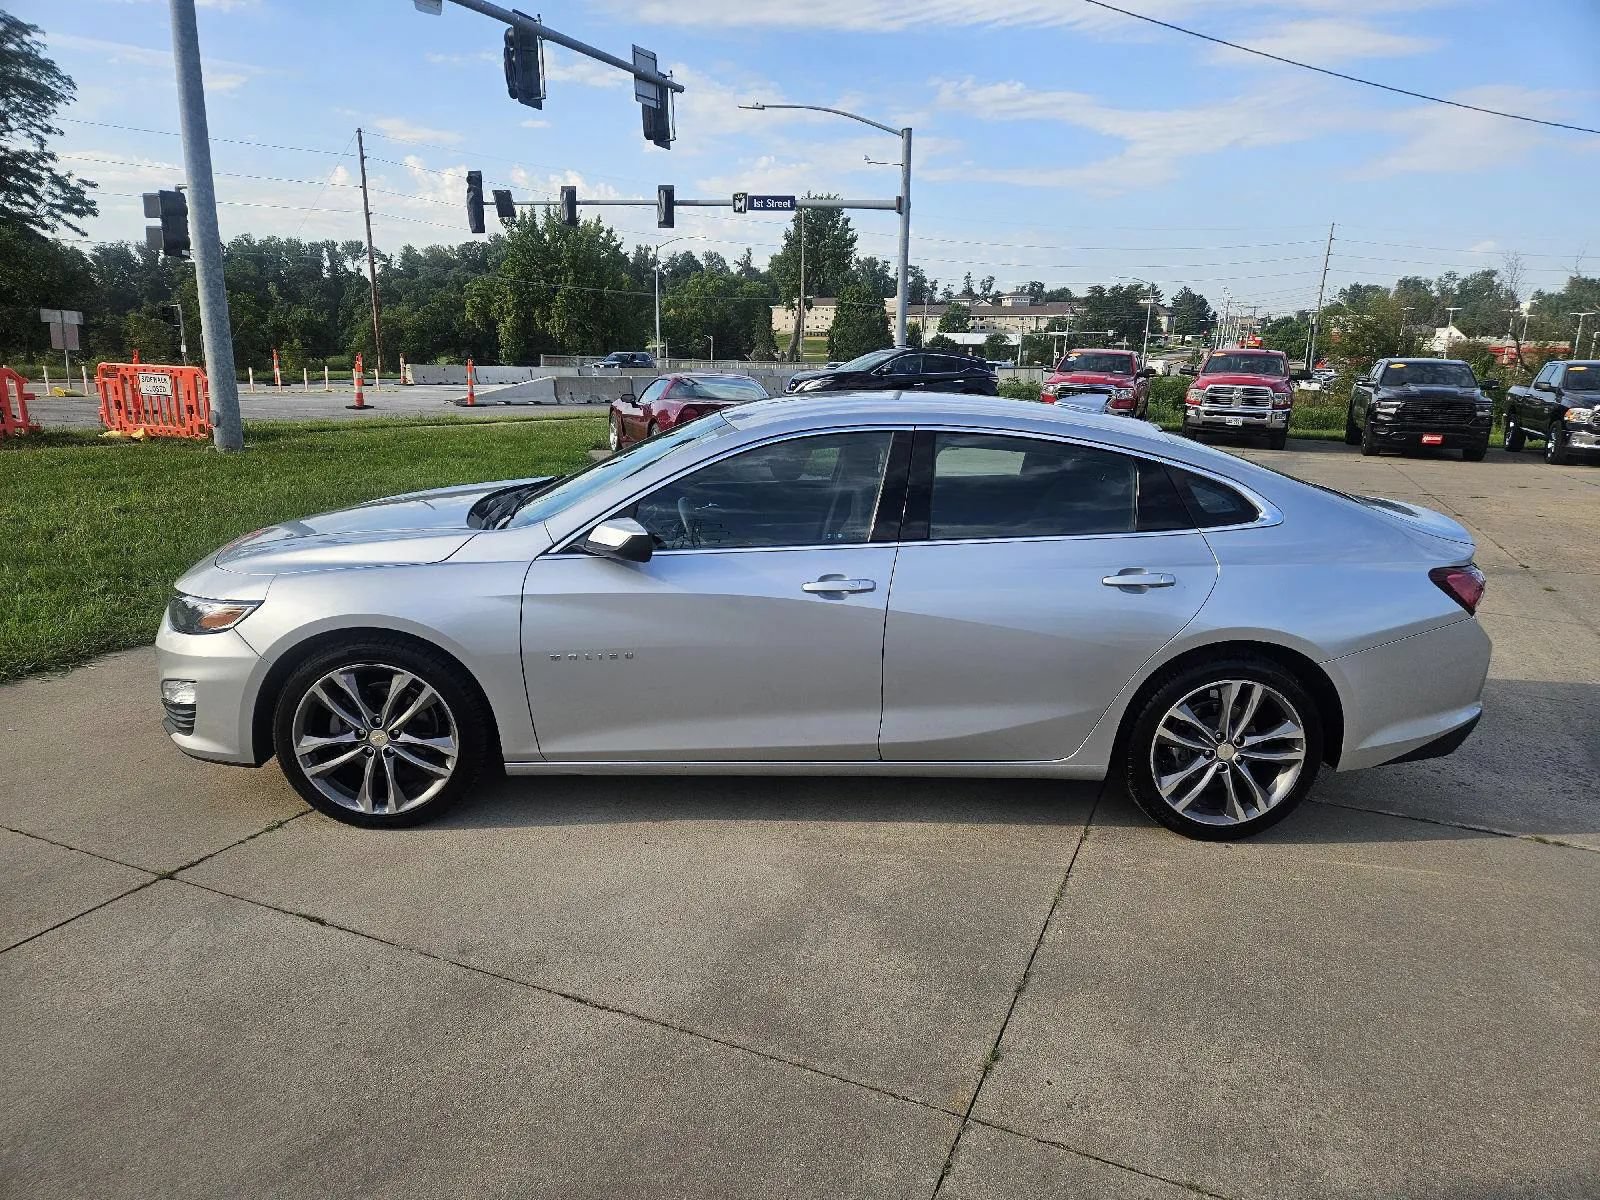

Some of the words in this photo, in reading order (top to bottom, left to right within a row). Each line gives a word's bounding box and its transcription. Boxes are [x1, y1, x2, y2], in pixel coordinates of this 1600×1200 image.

[753, 199, 764, 208] 1st
[766, 199, 791, 208] Street
[141, 375, 168, 384] SIDEWALK
[145, 385, 167, 393] CLOSED
[549, 652, 634, 661] MALIBU
